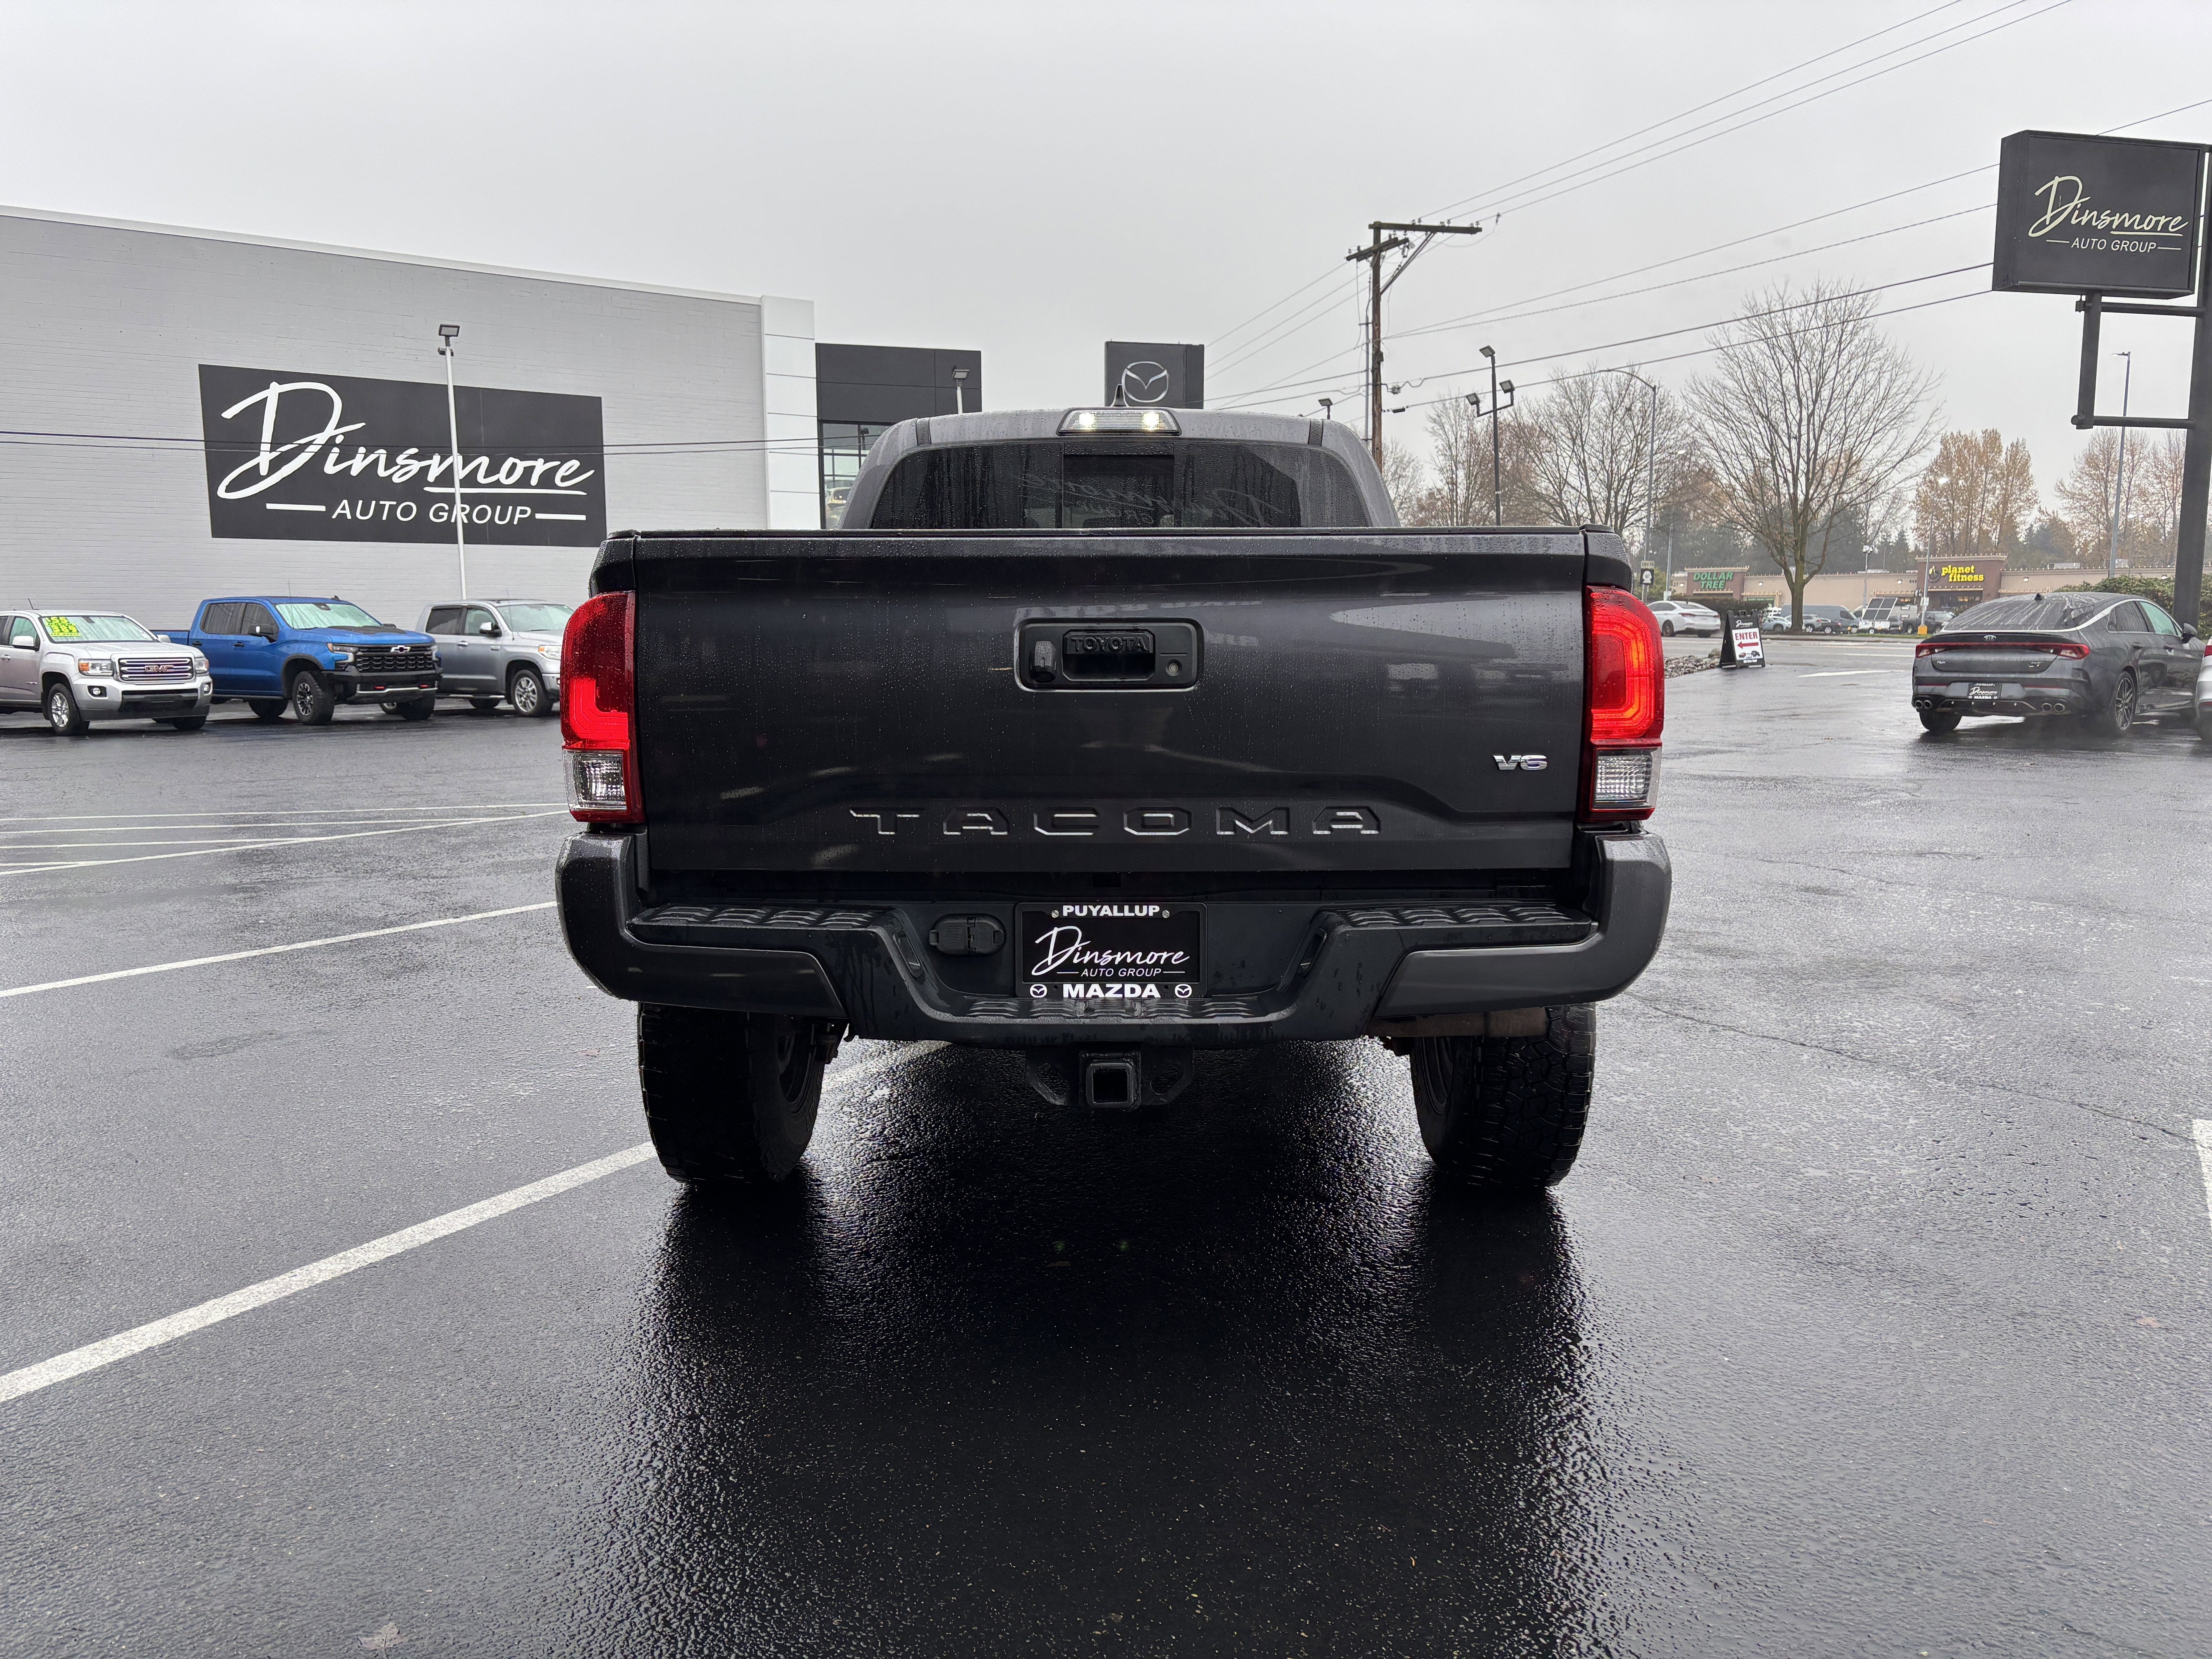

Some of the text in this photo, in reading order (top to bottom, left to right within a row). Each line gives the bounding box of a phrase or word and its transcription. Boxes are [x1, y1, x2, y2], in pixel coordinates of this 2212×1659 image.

[2028, 175, 2189, 237] Dinsmore
[2071, 237, 2157, 253] AUTO GROUP
[217, 381, 594, 499] Dinsmore
[332, 499, 532, 525] AUTO GROUP
[1693, 572, 1733, 581] DOLLAR
[1941, 565, 1975, 576] planet
[1949, 573, 1984, 582] fitness
[1700, 581, 1725, 589] TREE
[1735, 632, 1758, 641] ENTER
[1071, 637, 1148, 652] TOYOTA
[1493, 755, 1547, 770] V6
[850, 806, 1381, 836] TACOMA
[1062, 905, 1160, 917] PUYALLUP
[1031, 926, 1190, 976] Dinsmore
[1081, 968, 1162, 977] AUTO GROUP
[1063, 984, 1161, 998] MAZDA
